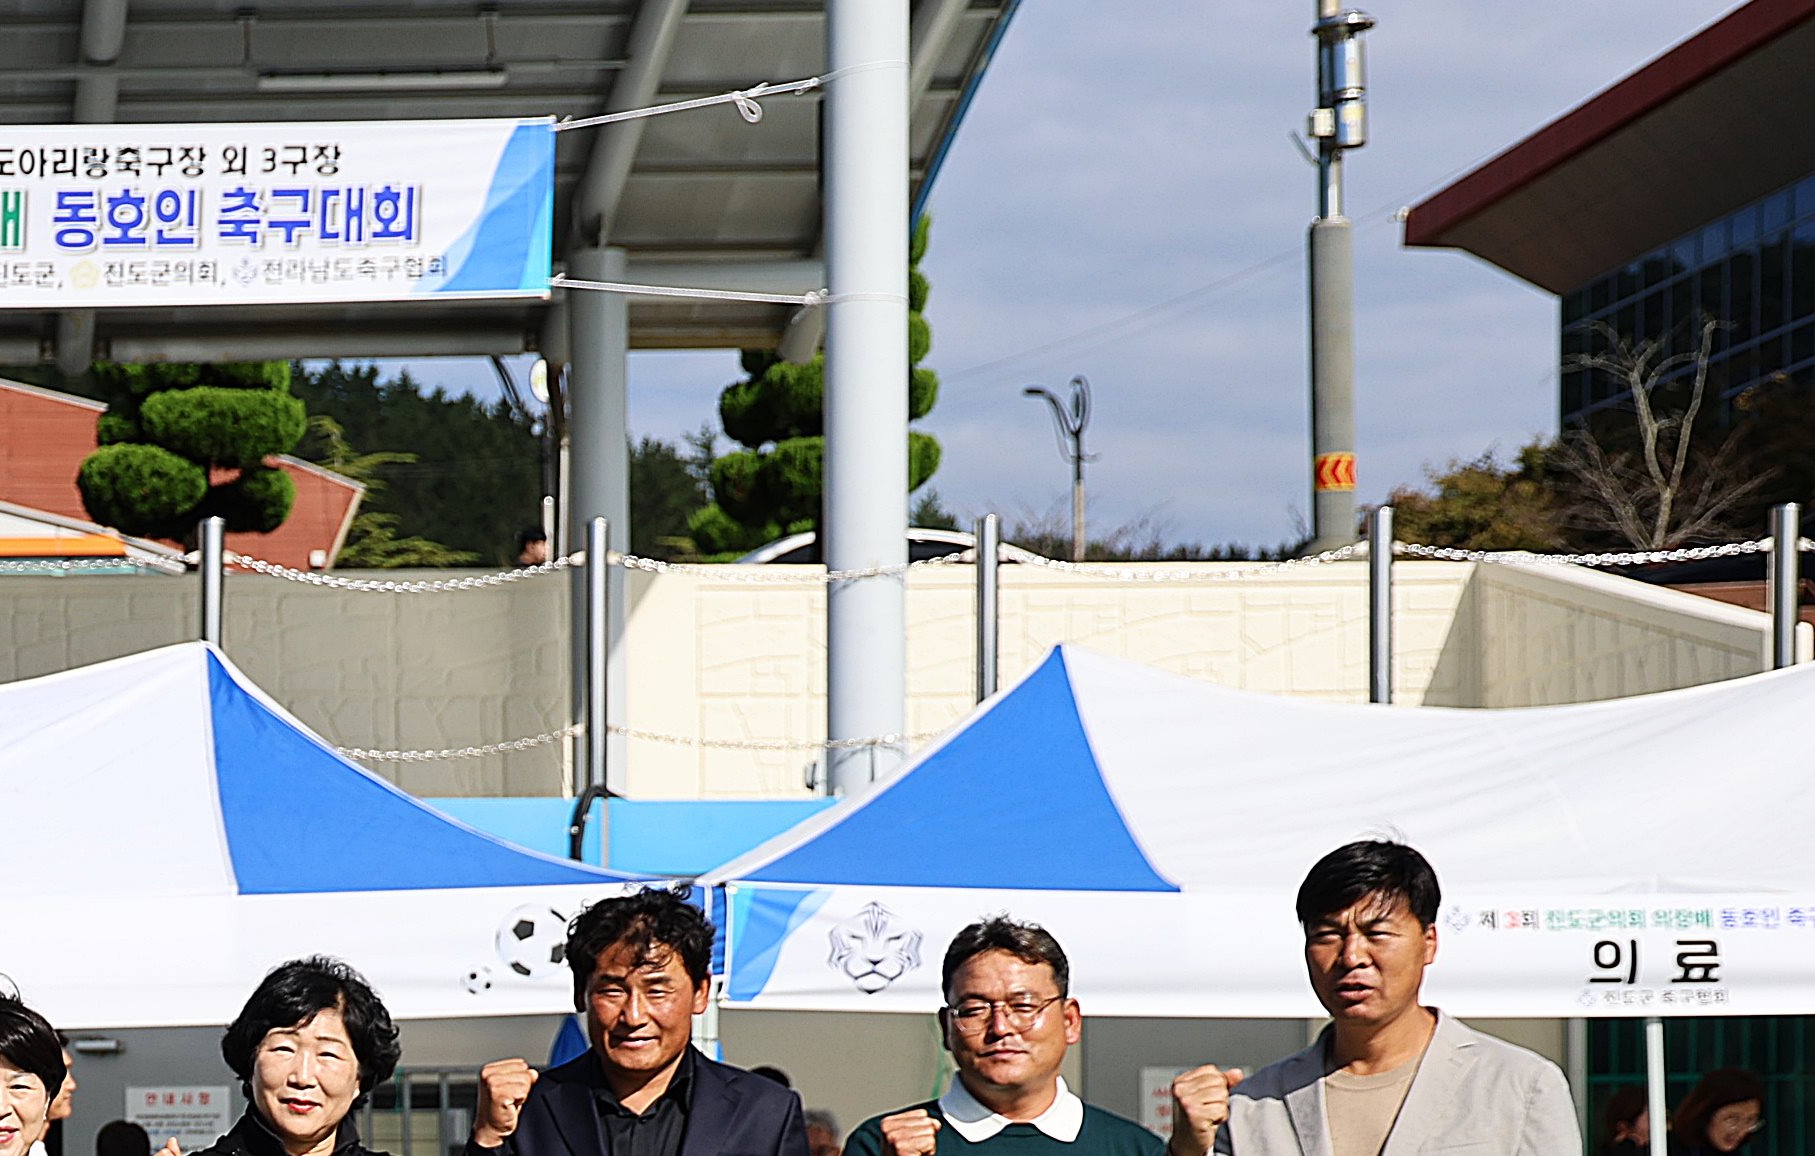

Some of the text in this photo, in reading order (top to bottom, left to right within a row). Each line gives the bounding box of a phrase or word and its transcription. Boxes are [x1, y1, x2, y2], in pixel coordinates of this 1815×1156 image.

[221, 145, 248, 178] 외
[261, 144, 342, 176] 3구장
[53, 187, 198, 248] 동호인
[218, 185, 416, 245] 축구대회
[263, 255, 448, 283] 전라남도축구협회
[1589, 939, 1721, 985] 의 료
